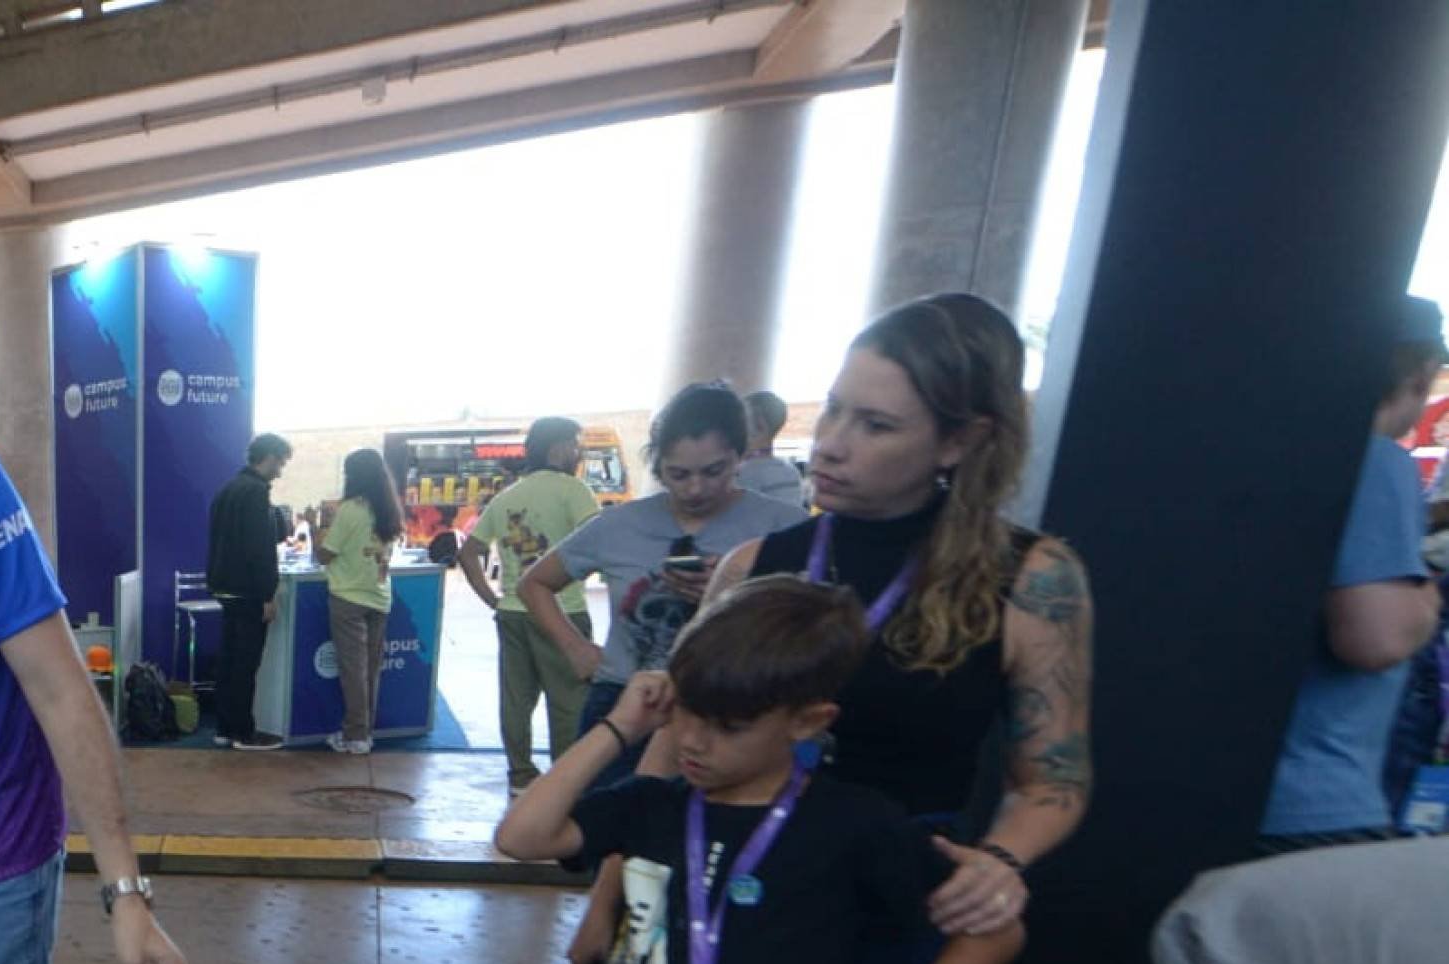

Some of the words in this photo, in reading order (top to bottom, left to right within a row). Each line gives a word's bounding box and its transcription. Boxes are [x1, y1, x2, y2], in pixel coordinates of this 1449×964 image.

[84, 377, 127, 397] campus
[187, 374, 240, 391] campus
[85, 395, 118, 413] future
[187, 388, 230, 405] future
